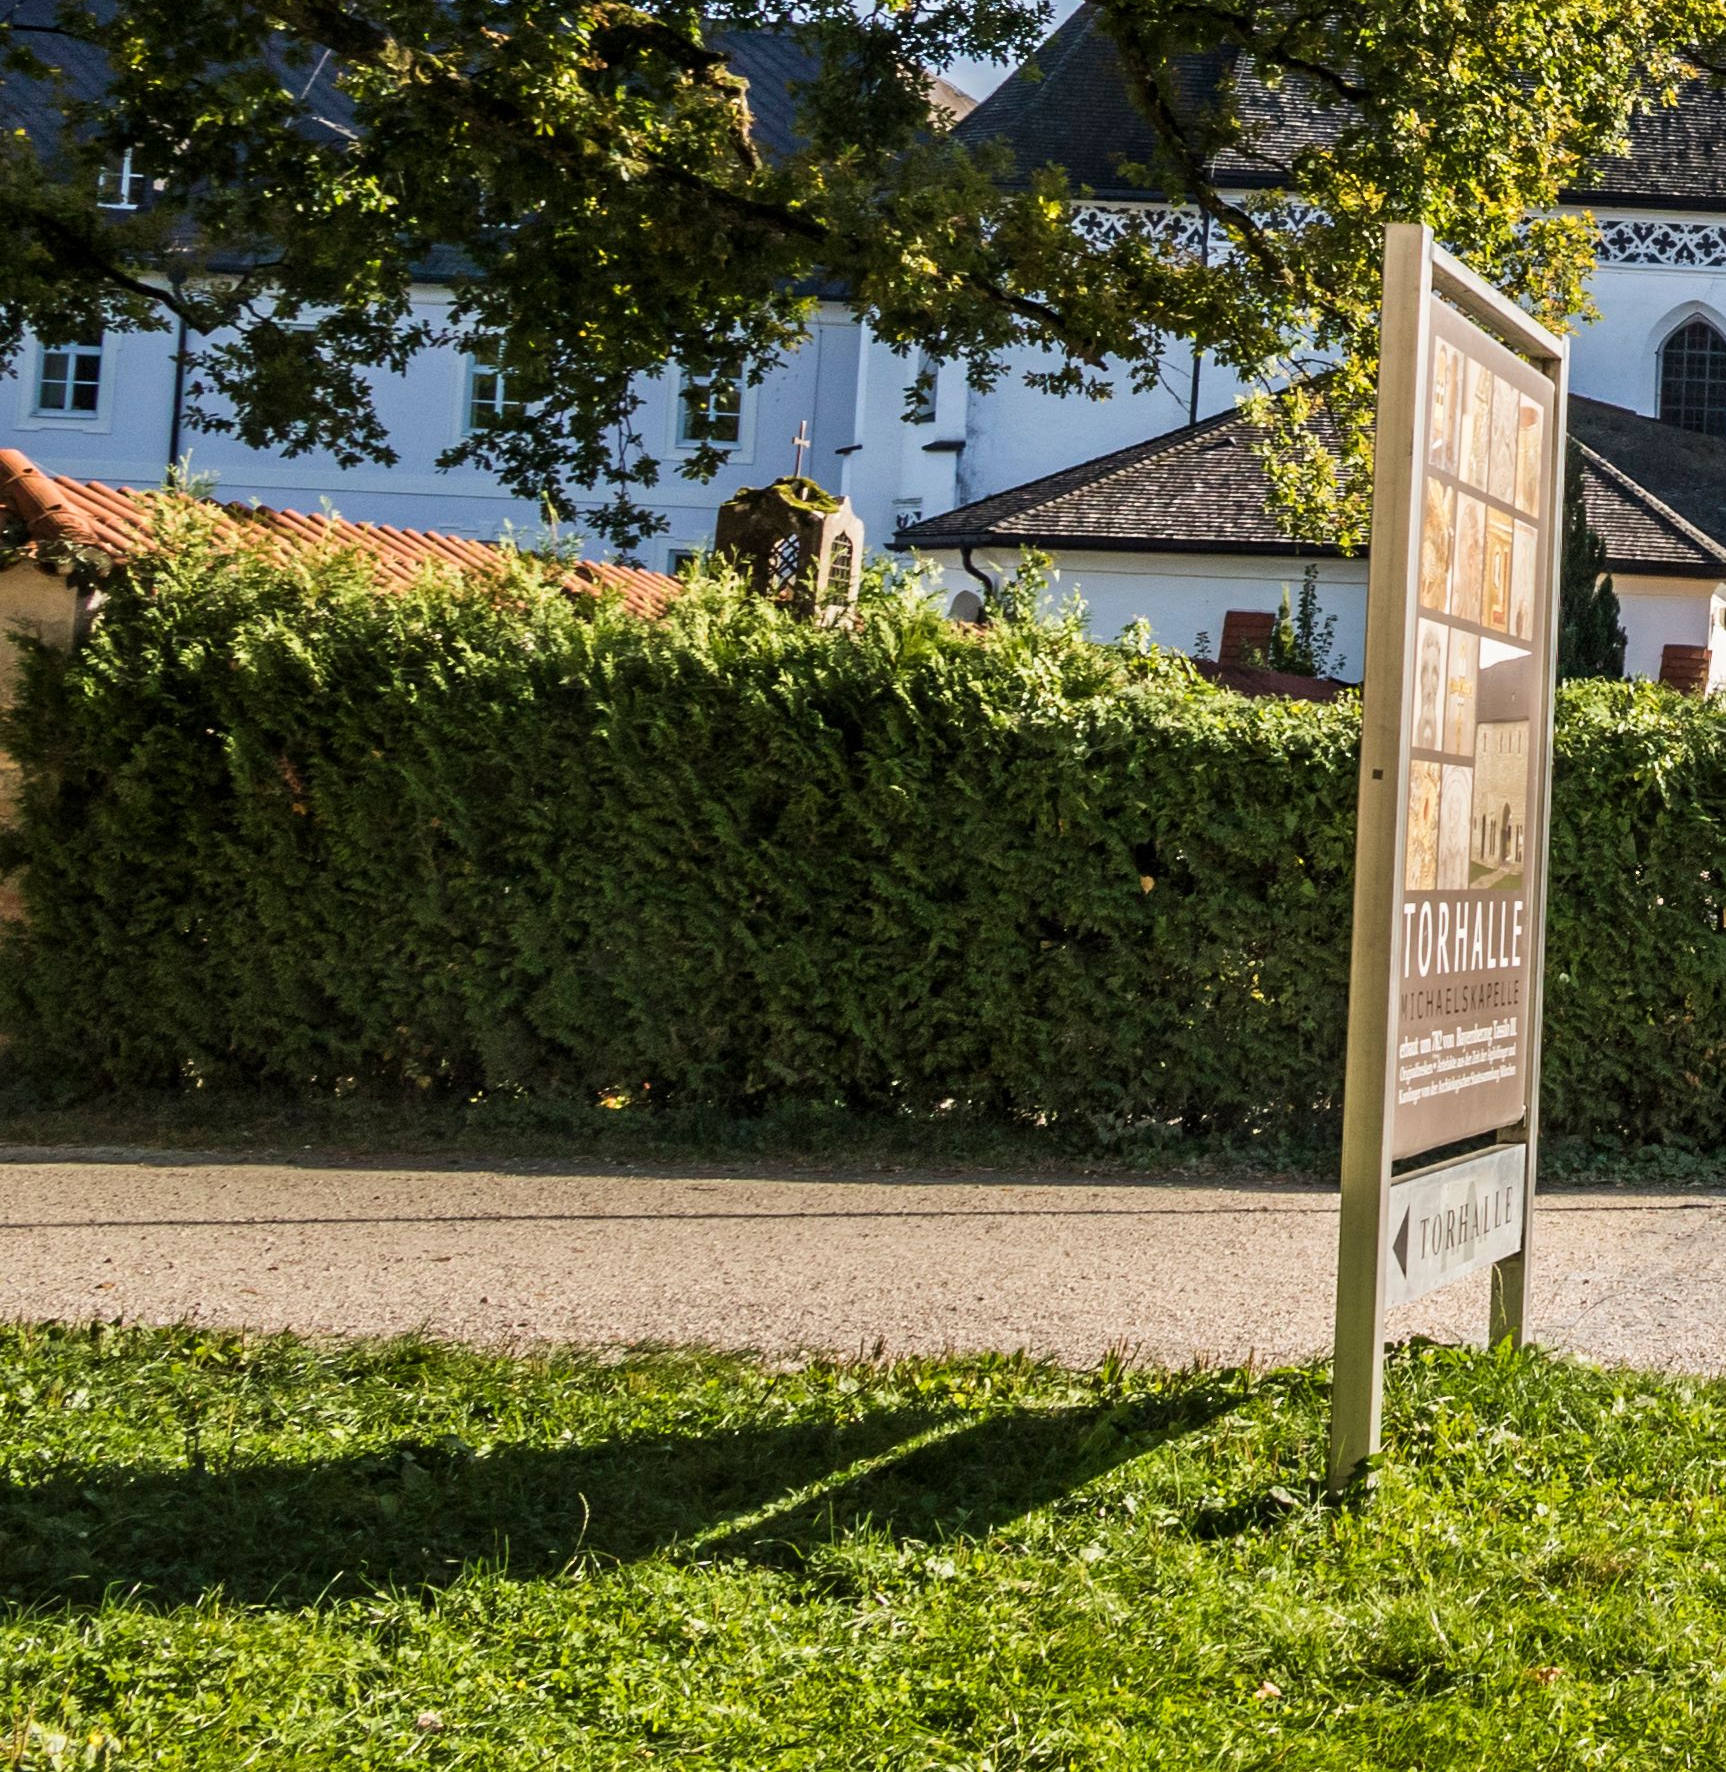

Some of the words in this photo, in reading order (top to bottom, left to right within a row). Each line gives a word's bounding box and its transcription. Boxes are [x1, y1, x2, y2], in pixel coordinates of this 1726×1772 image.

[1404, 901, 1523, 978] TORHALLE
[1401, 980, 1519, 1021] MICHAELSKAPELLE
[1420, 1186, 1512, 1260] TORHALLE
